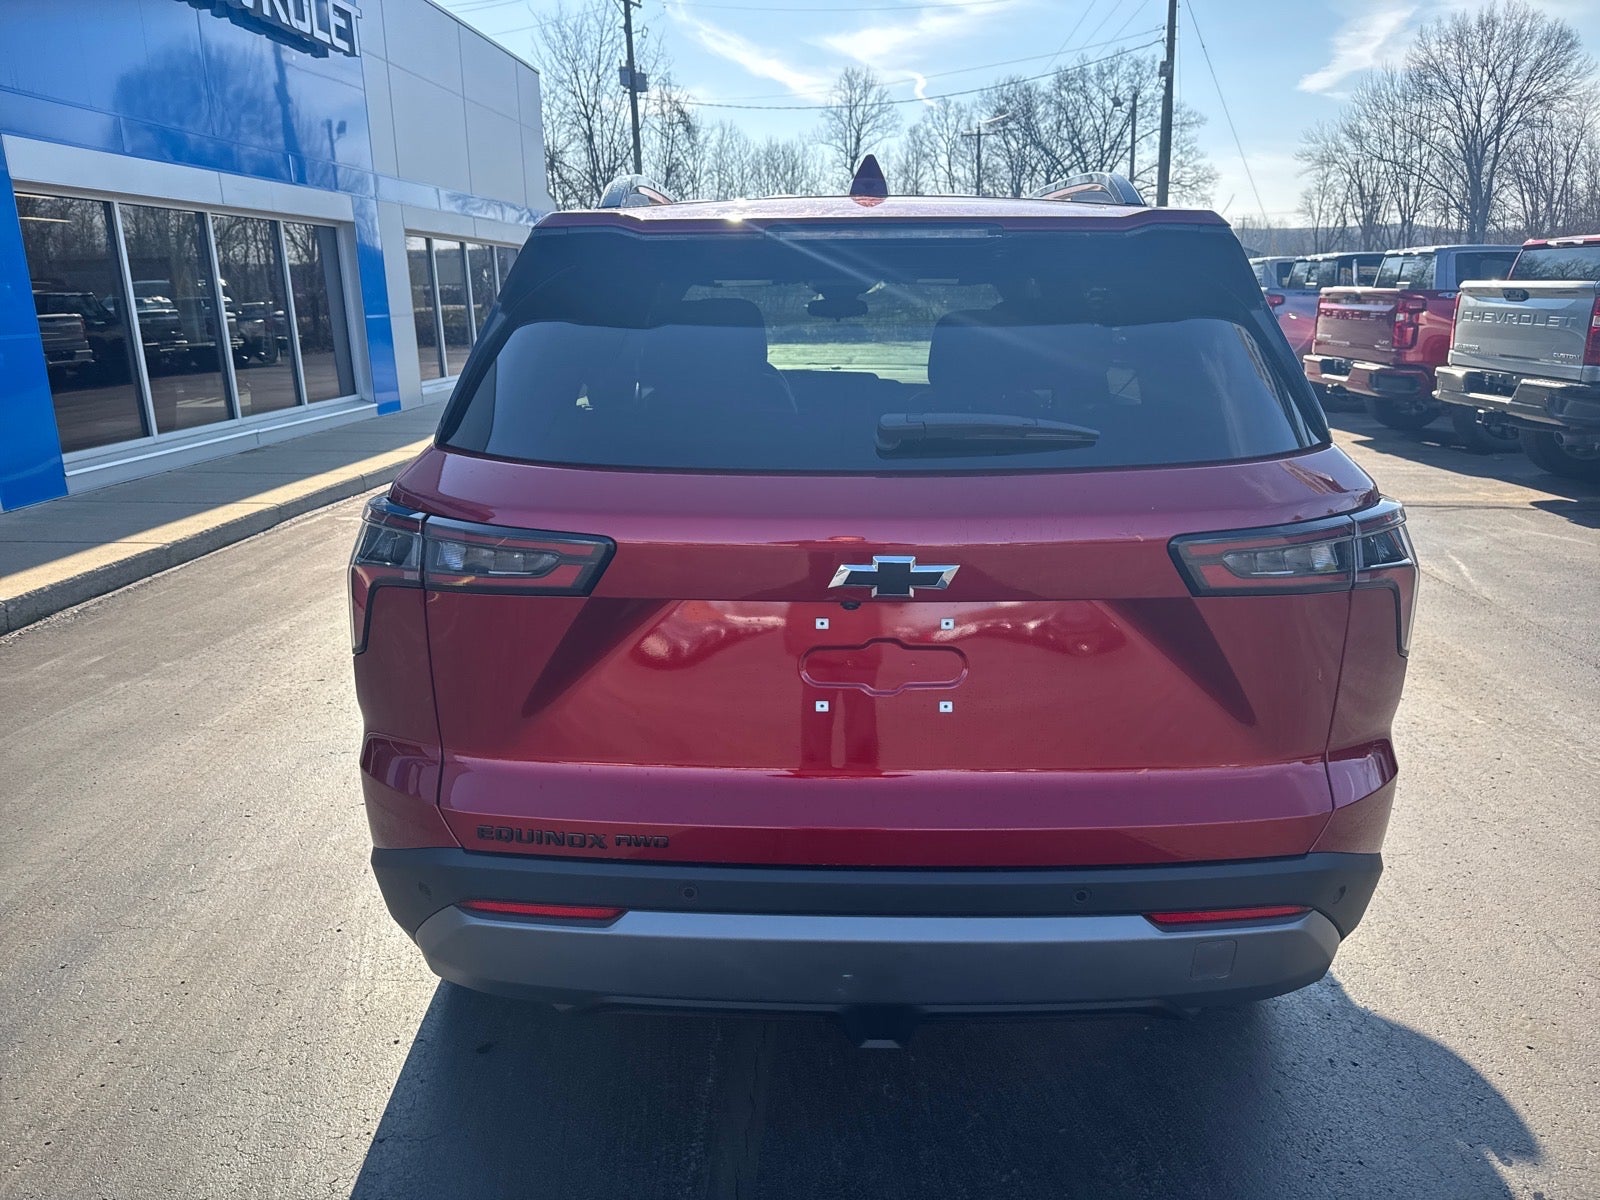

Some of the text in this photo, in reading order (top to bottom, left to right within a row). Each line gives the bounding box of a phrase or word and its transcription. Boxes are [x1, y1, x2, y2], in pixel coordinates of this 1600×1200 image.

[1462, 311, 1577, 328] CHEVROLET
[476, 825, 670, 850] EQUINOX AWD
